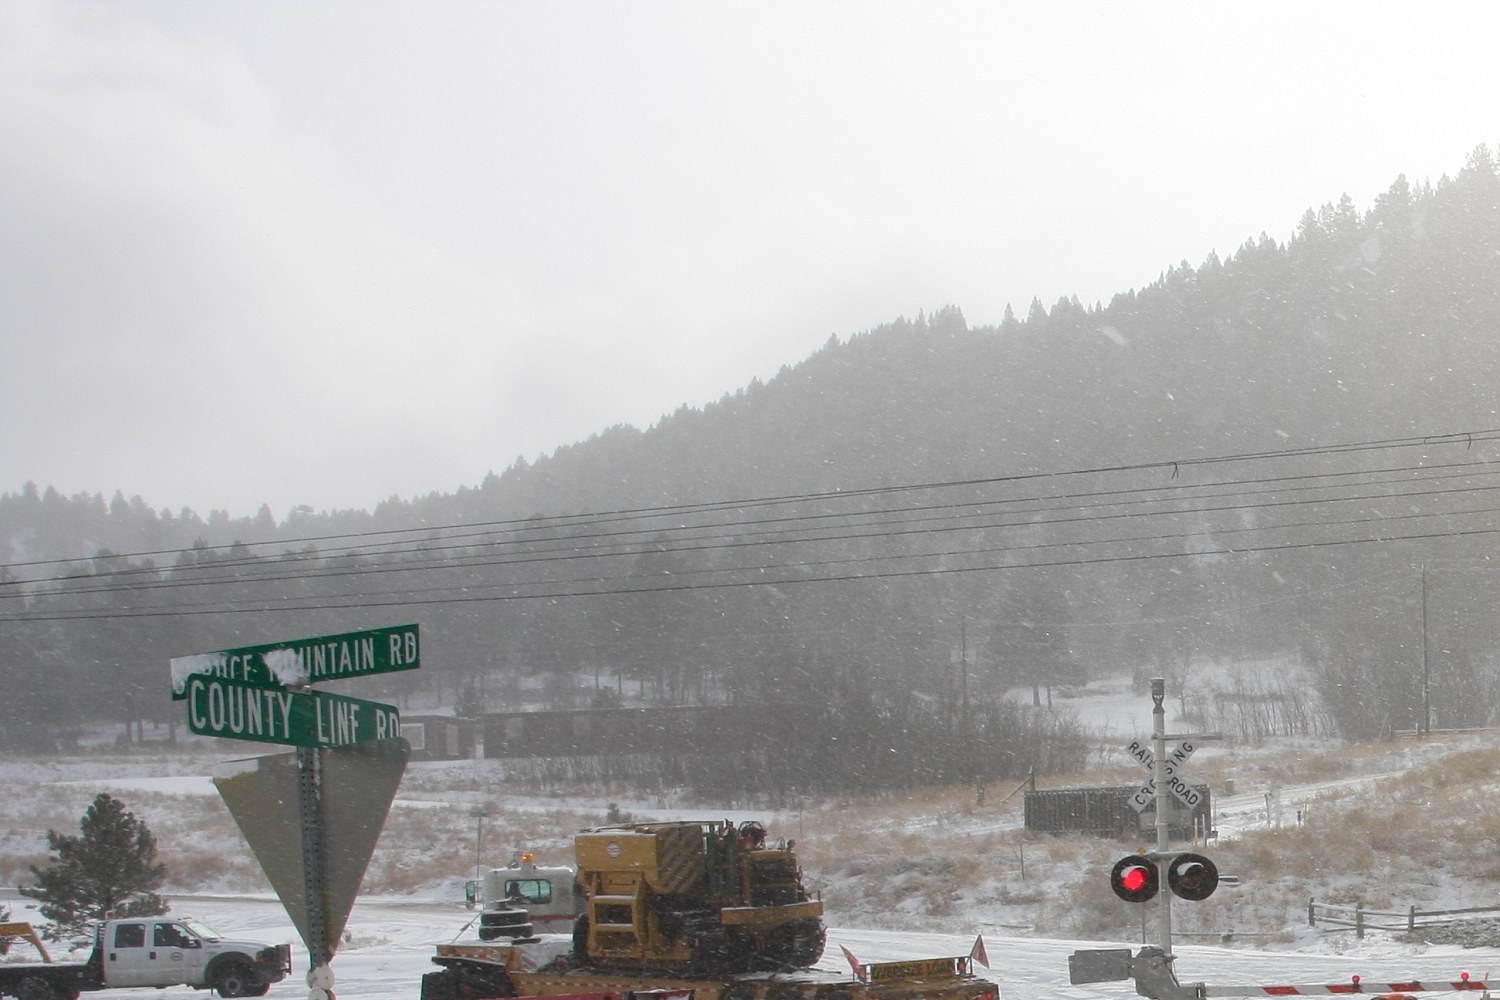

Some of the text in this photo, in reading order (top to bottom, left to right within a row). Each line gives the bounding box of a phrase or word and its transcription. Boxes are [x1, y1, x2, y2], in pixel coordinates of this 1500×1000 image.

[390, 631, 417, 665] RD
[190, 680, 294, 739] COUNTY
[1170, 776, 1198, 805] ROAD
